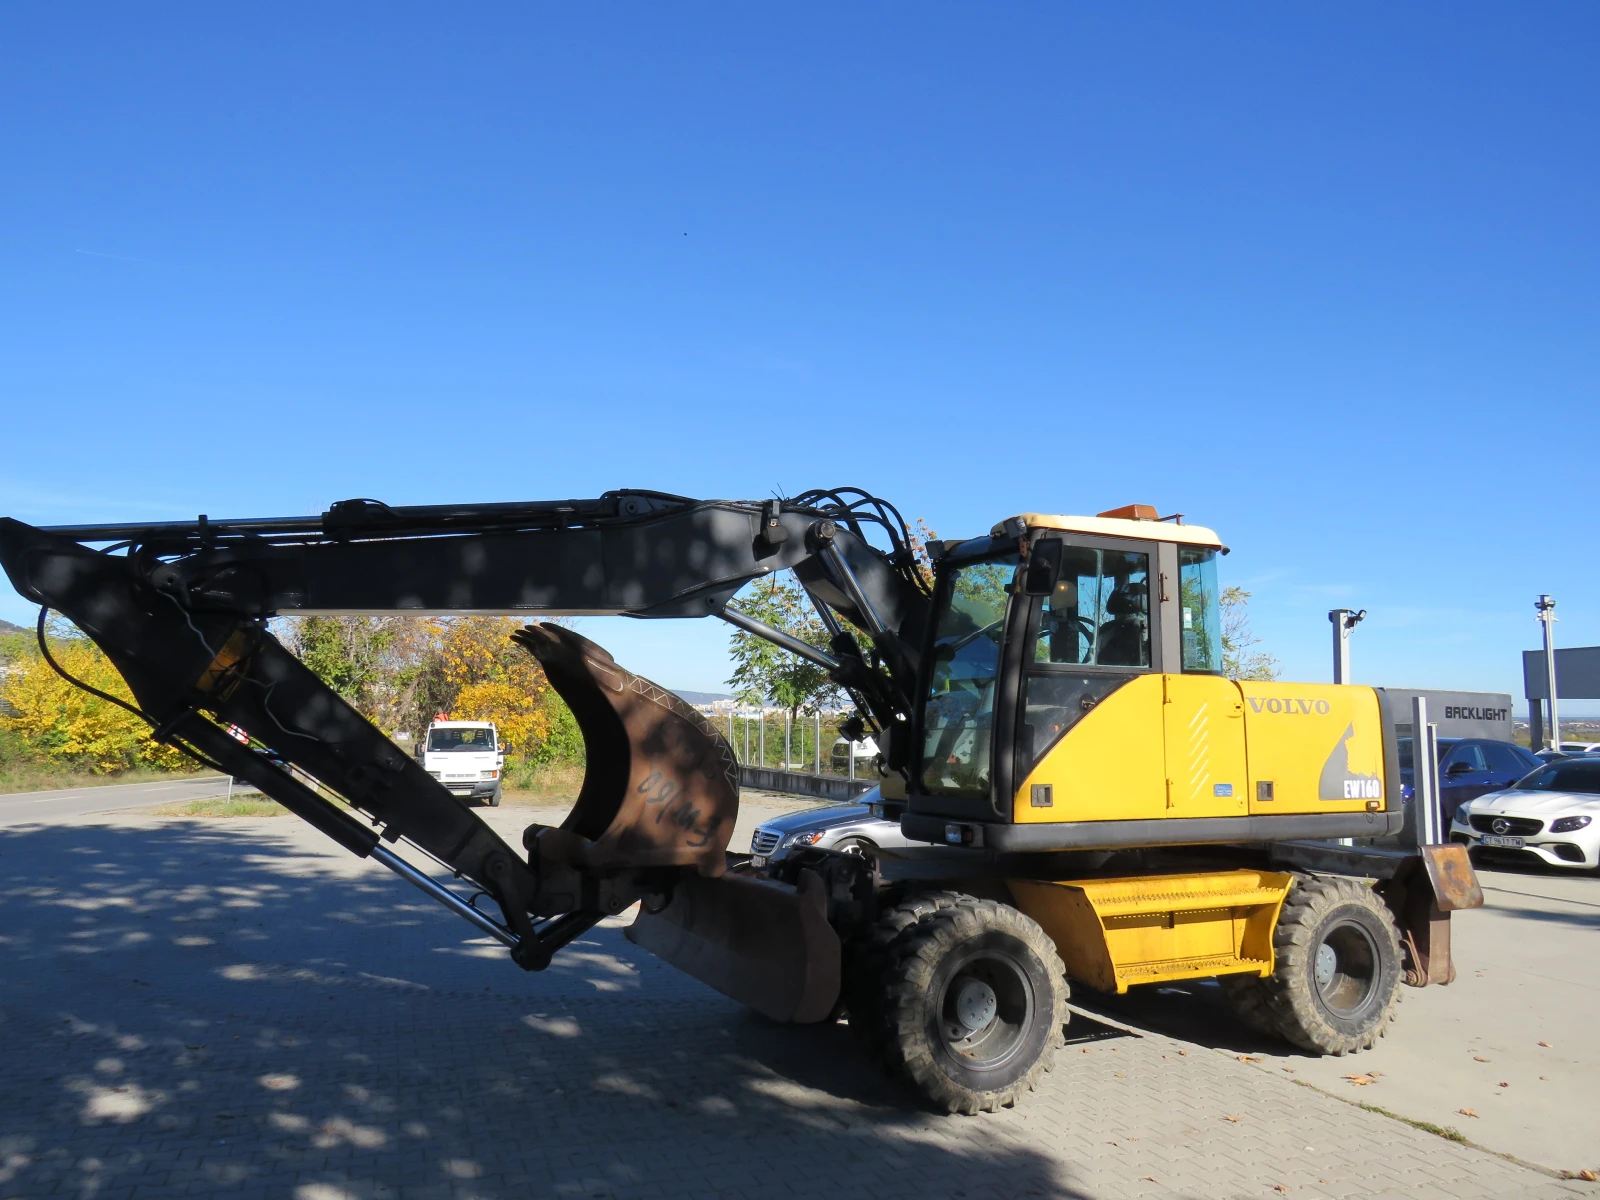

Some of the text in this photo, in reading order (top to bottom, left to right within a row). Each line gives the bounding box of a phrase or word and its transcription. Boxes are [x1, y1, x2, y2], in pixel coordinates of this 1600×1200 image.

[1246, 697, 1330, 715] VOLVO
[1445, 706, 1507, 721] BACKLIGHT
[1343, 780, 1380, 799] EW160
